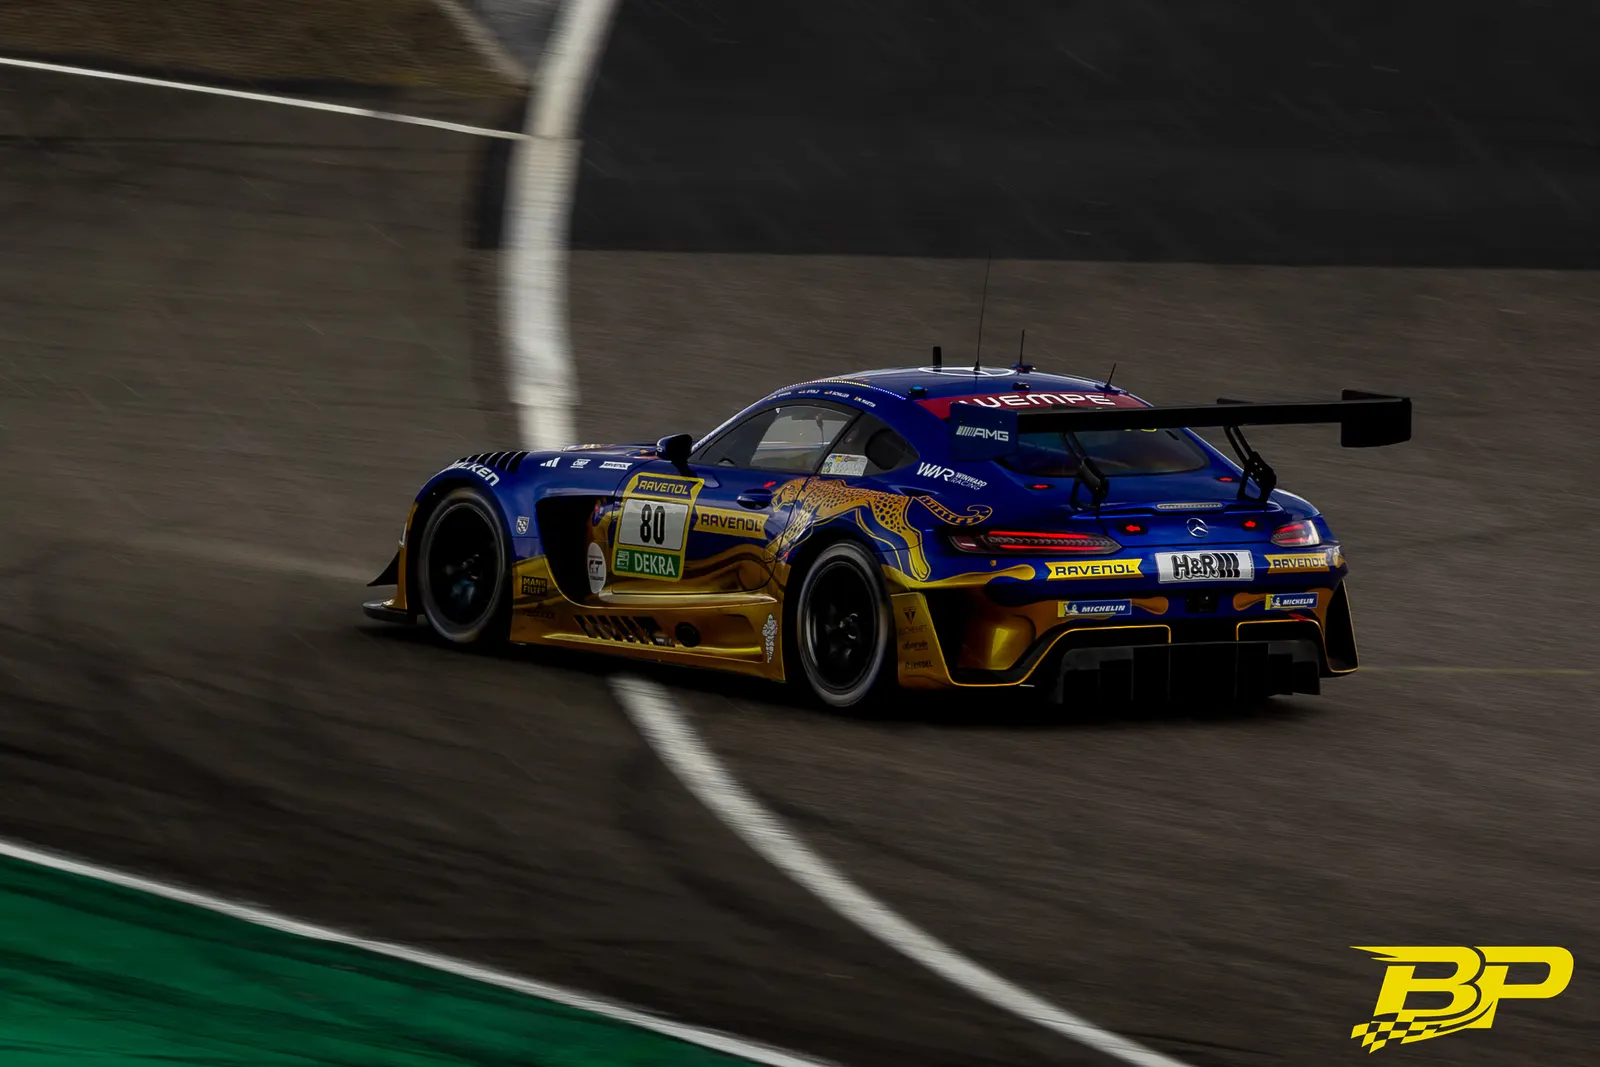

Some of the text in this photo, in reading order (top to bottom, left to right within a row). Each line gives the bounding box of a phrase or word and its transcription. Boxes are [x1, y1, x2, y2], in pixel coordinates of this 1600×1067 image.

[972, 428, 1009, 442] AMG
[950, 477, 981, 490] RACING
[955, 472, 988, 487] WINWARD
[638, 480, 689, 495] RAVENOL
[640, 504, 666, 545] 80
[701, 514, 761, 532] RAVENOL
[634, 552, 676, 576] DEKRA
[1272, 556, 1326, 569] RAVENOL
[1055, 564, 1136, 576] RAVENOL
[1081, 604, 1126, 613] MICHELIN
[1282, 597, 1314, 606] MICHELIN
